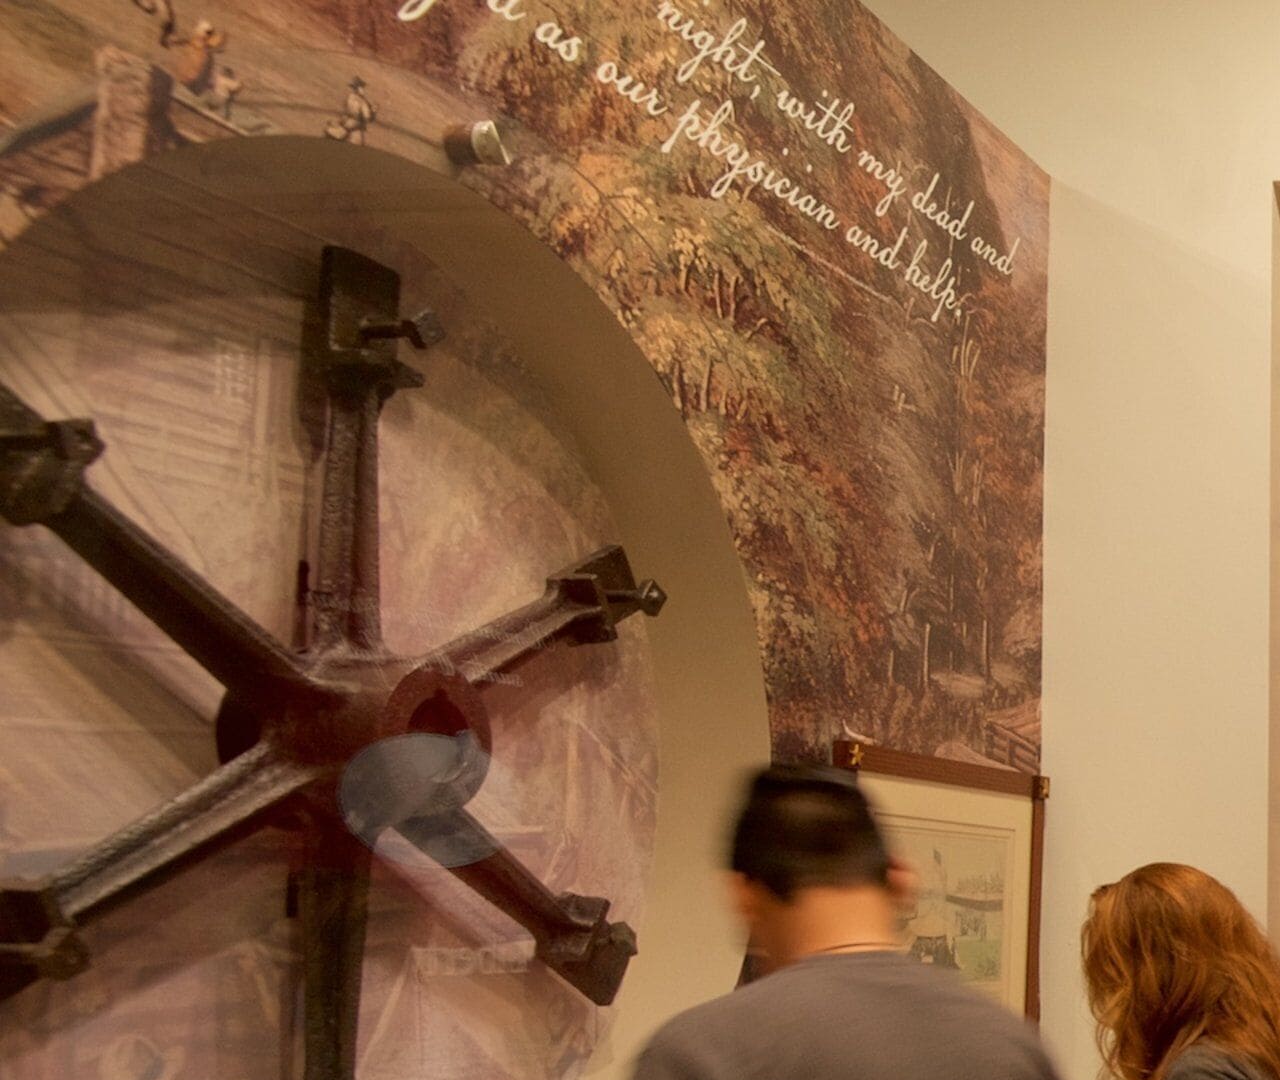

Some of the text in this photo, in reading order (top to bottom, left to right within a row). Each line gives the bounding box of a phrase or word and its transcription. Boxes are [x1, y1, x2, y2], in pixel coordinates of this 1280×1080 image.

[535, 22, 962, 322] as our physician and help.
[657, 0, 1021, 275] night, with my dead and
